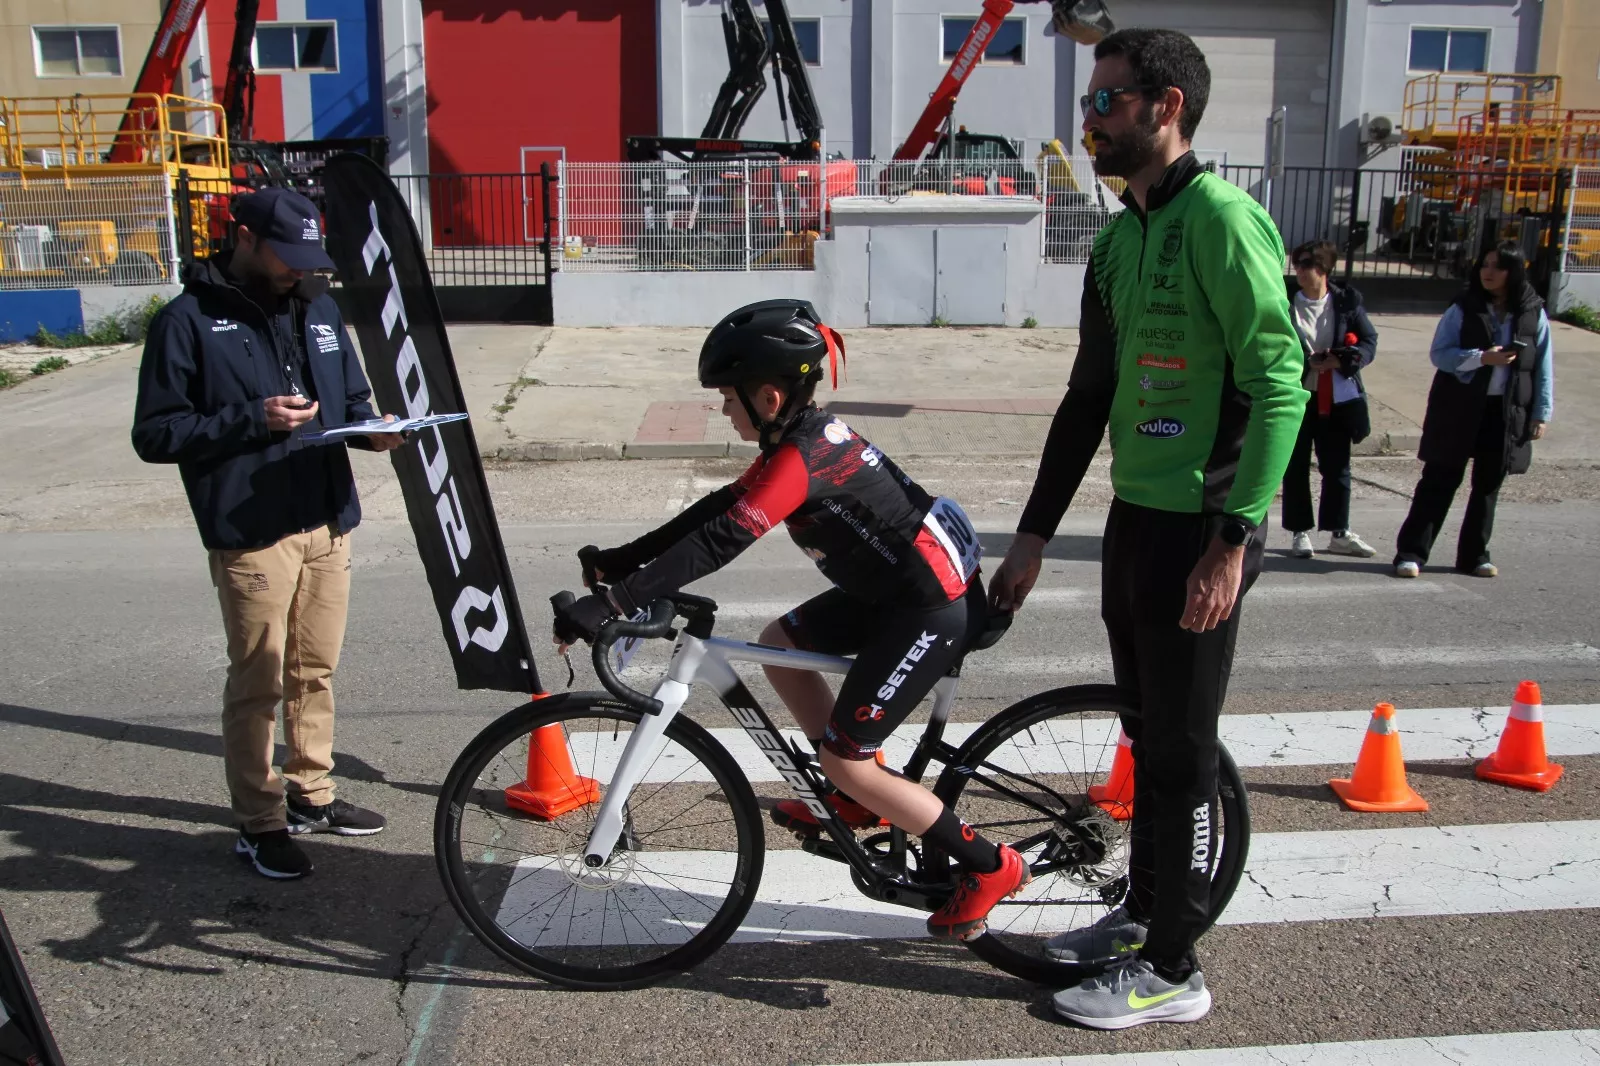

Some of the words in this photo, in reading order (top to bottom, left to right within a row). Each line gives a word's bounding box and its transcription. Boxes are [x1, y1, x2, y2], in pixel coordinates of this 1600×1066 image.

[951, 21, 991, 81] MANITOU
[696, 140, 741, 152] MANITOU
[211, 323, 238, 333] amura
[1139, 419, 1178, 434] vulco
[842, 510, 870, 541] Ciclista
[870, 536, 899, 566] Turiaso
[935, 503, 973, 556] 60
[876, 630, 938, 701] SETEK
